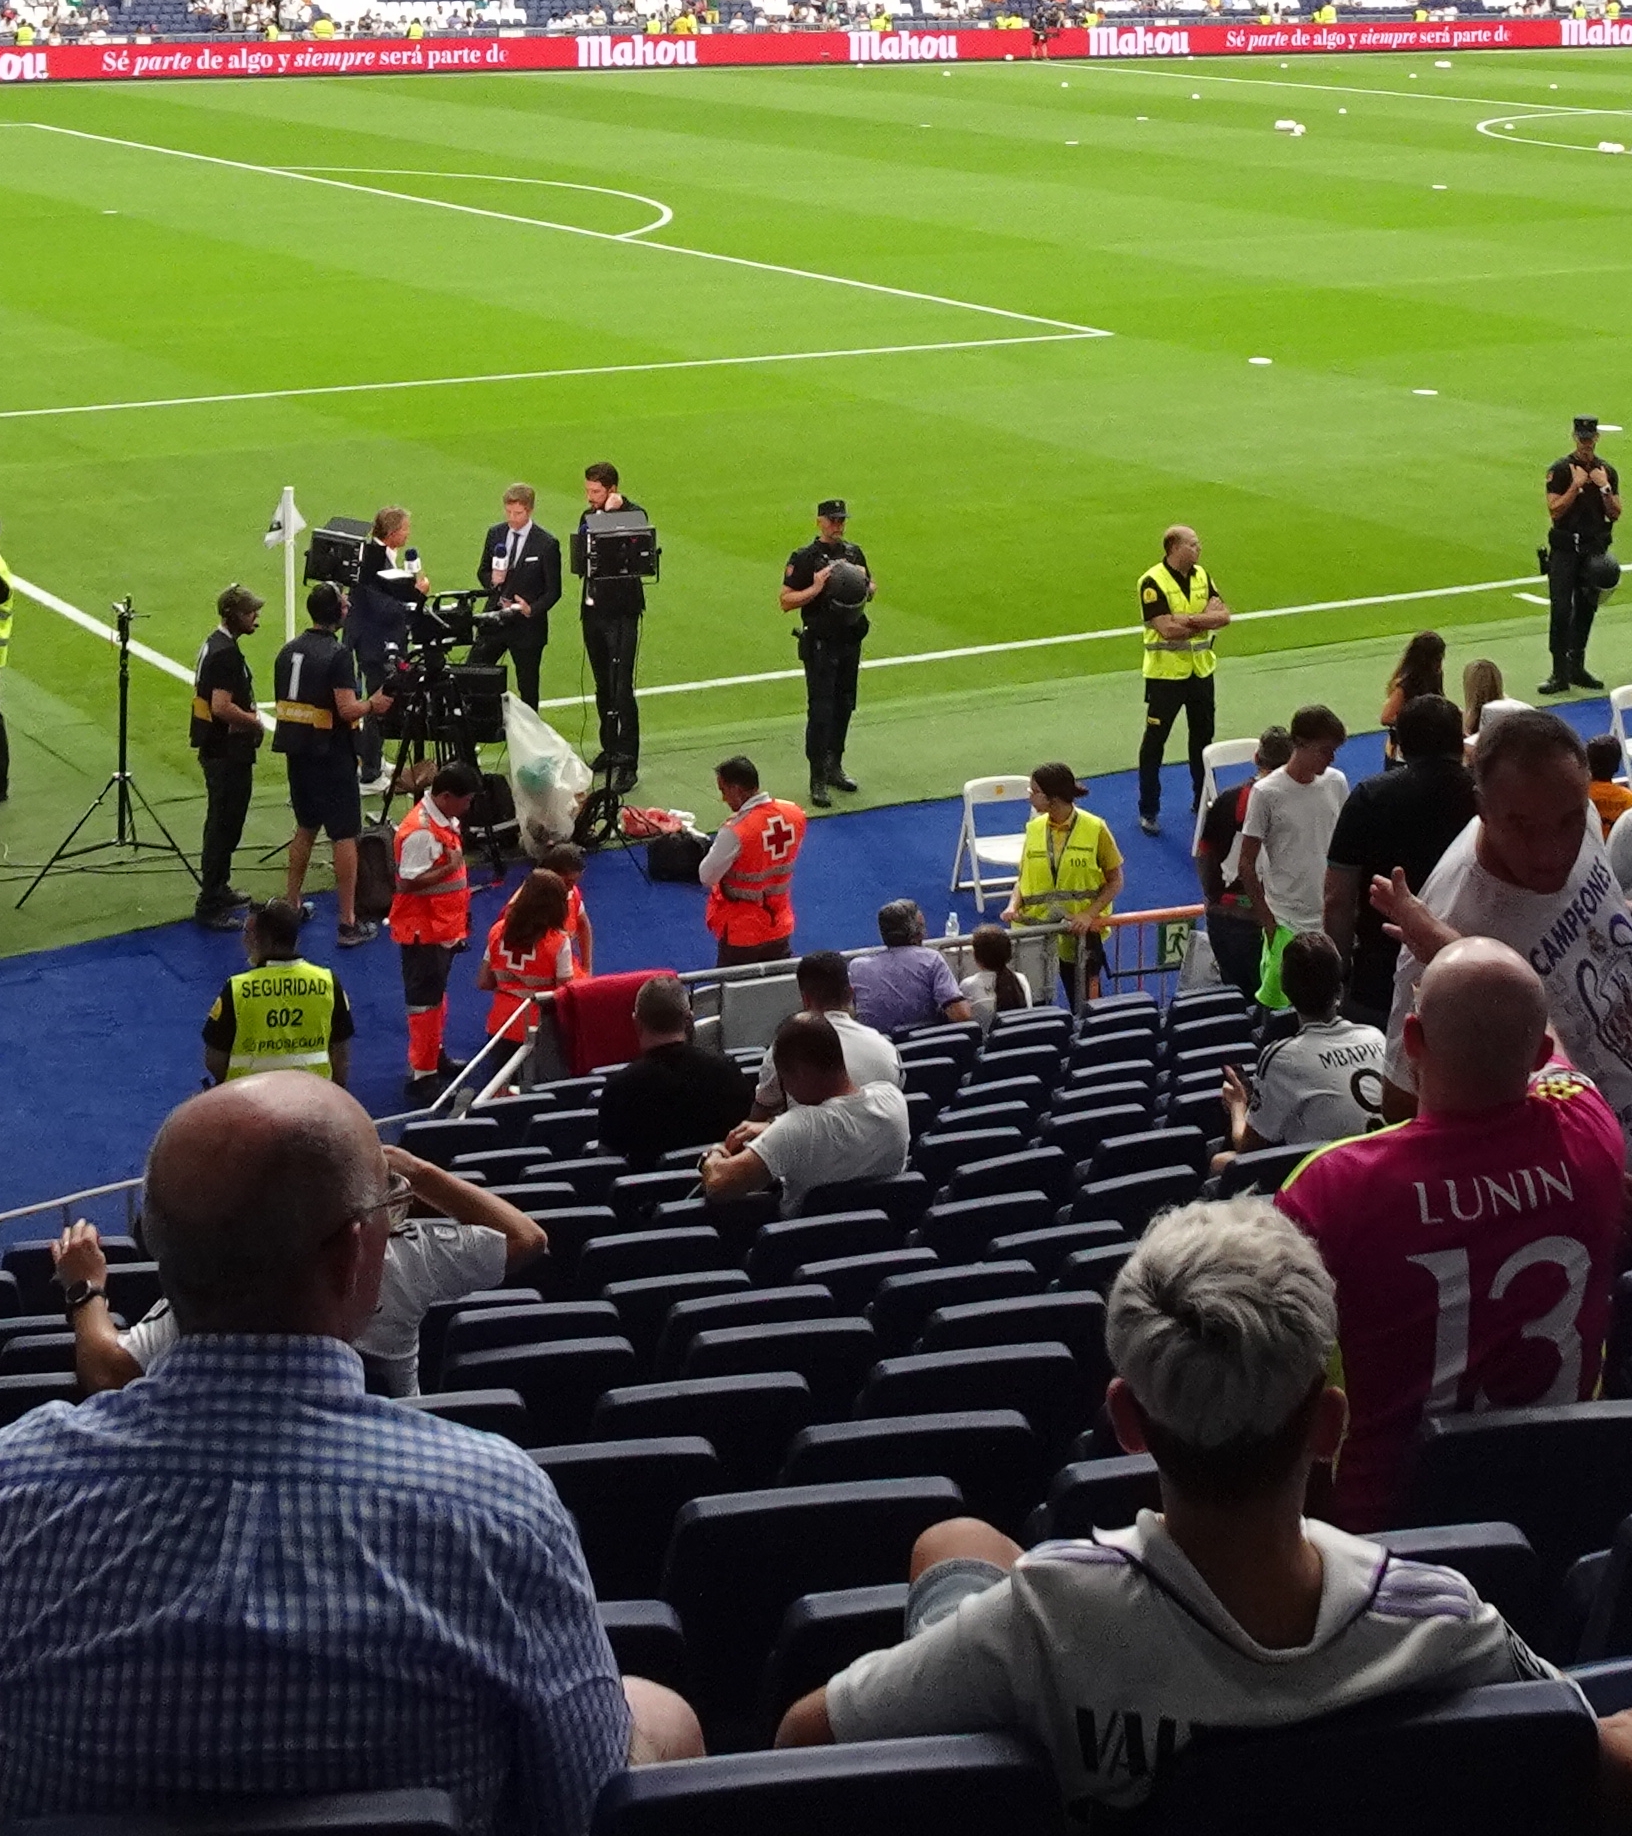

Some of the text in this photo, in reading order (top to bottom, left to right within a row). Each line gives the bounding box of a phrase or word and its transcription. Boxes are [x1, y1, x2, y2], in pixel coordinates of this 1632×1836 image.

[575, 35, 698, 66] Mahou
[848, 31, 958, 62] Mahou
[1088, 26, 1190, 56] Mahou
[1226, 28, 1246, 47] Sé
[1247, 30, 1289, 51] parte
[1291, 27, 1311, 46] de
[1313, 27, 1346, 50] algo
[1348, 31, 1358, 50] y
[1359, 27, 1417, 48] siempre
[1419, 25, 1451, 44] será
[1453, 26, 1492, 47] parte
[101, 50, 130, 71] Sé
[133, 52, 193, 75] parte
[196, 48, 224, 70] de
[228, 47, 273, 73] algo
[277, 52, 292, 72] y
[294, 47, 377, 71] siempre
[380, 44, 421, 65] será
[428, 45, 482, 69] parte
[1070, 857, 1087, 868] 105
[241, 977, 327, 999] SEGURIDAD
[266, 1008, 304, 1028] 602
[258, 1036, 325, 1052] PROSEGUR
[1413, 1162, 1574, 1226] LUNIN
[1406, 1235, 1593, 1411] 13
